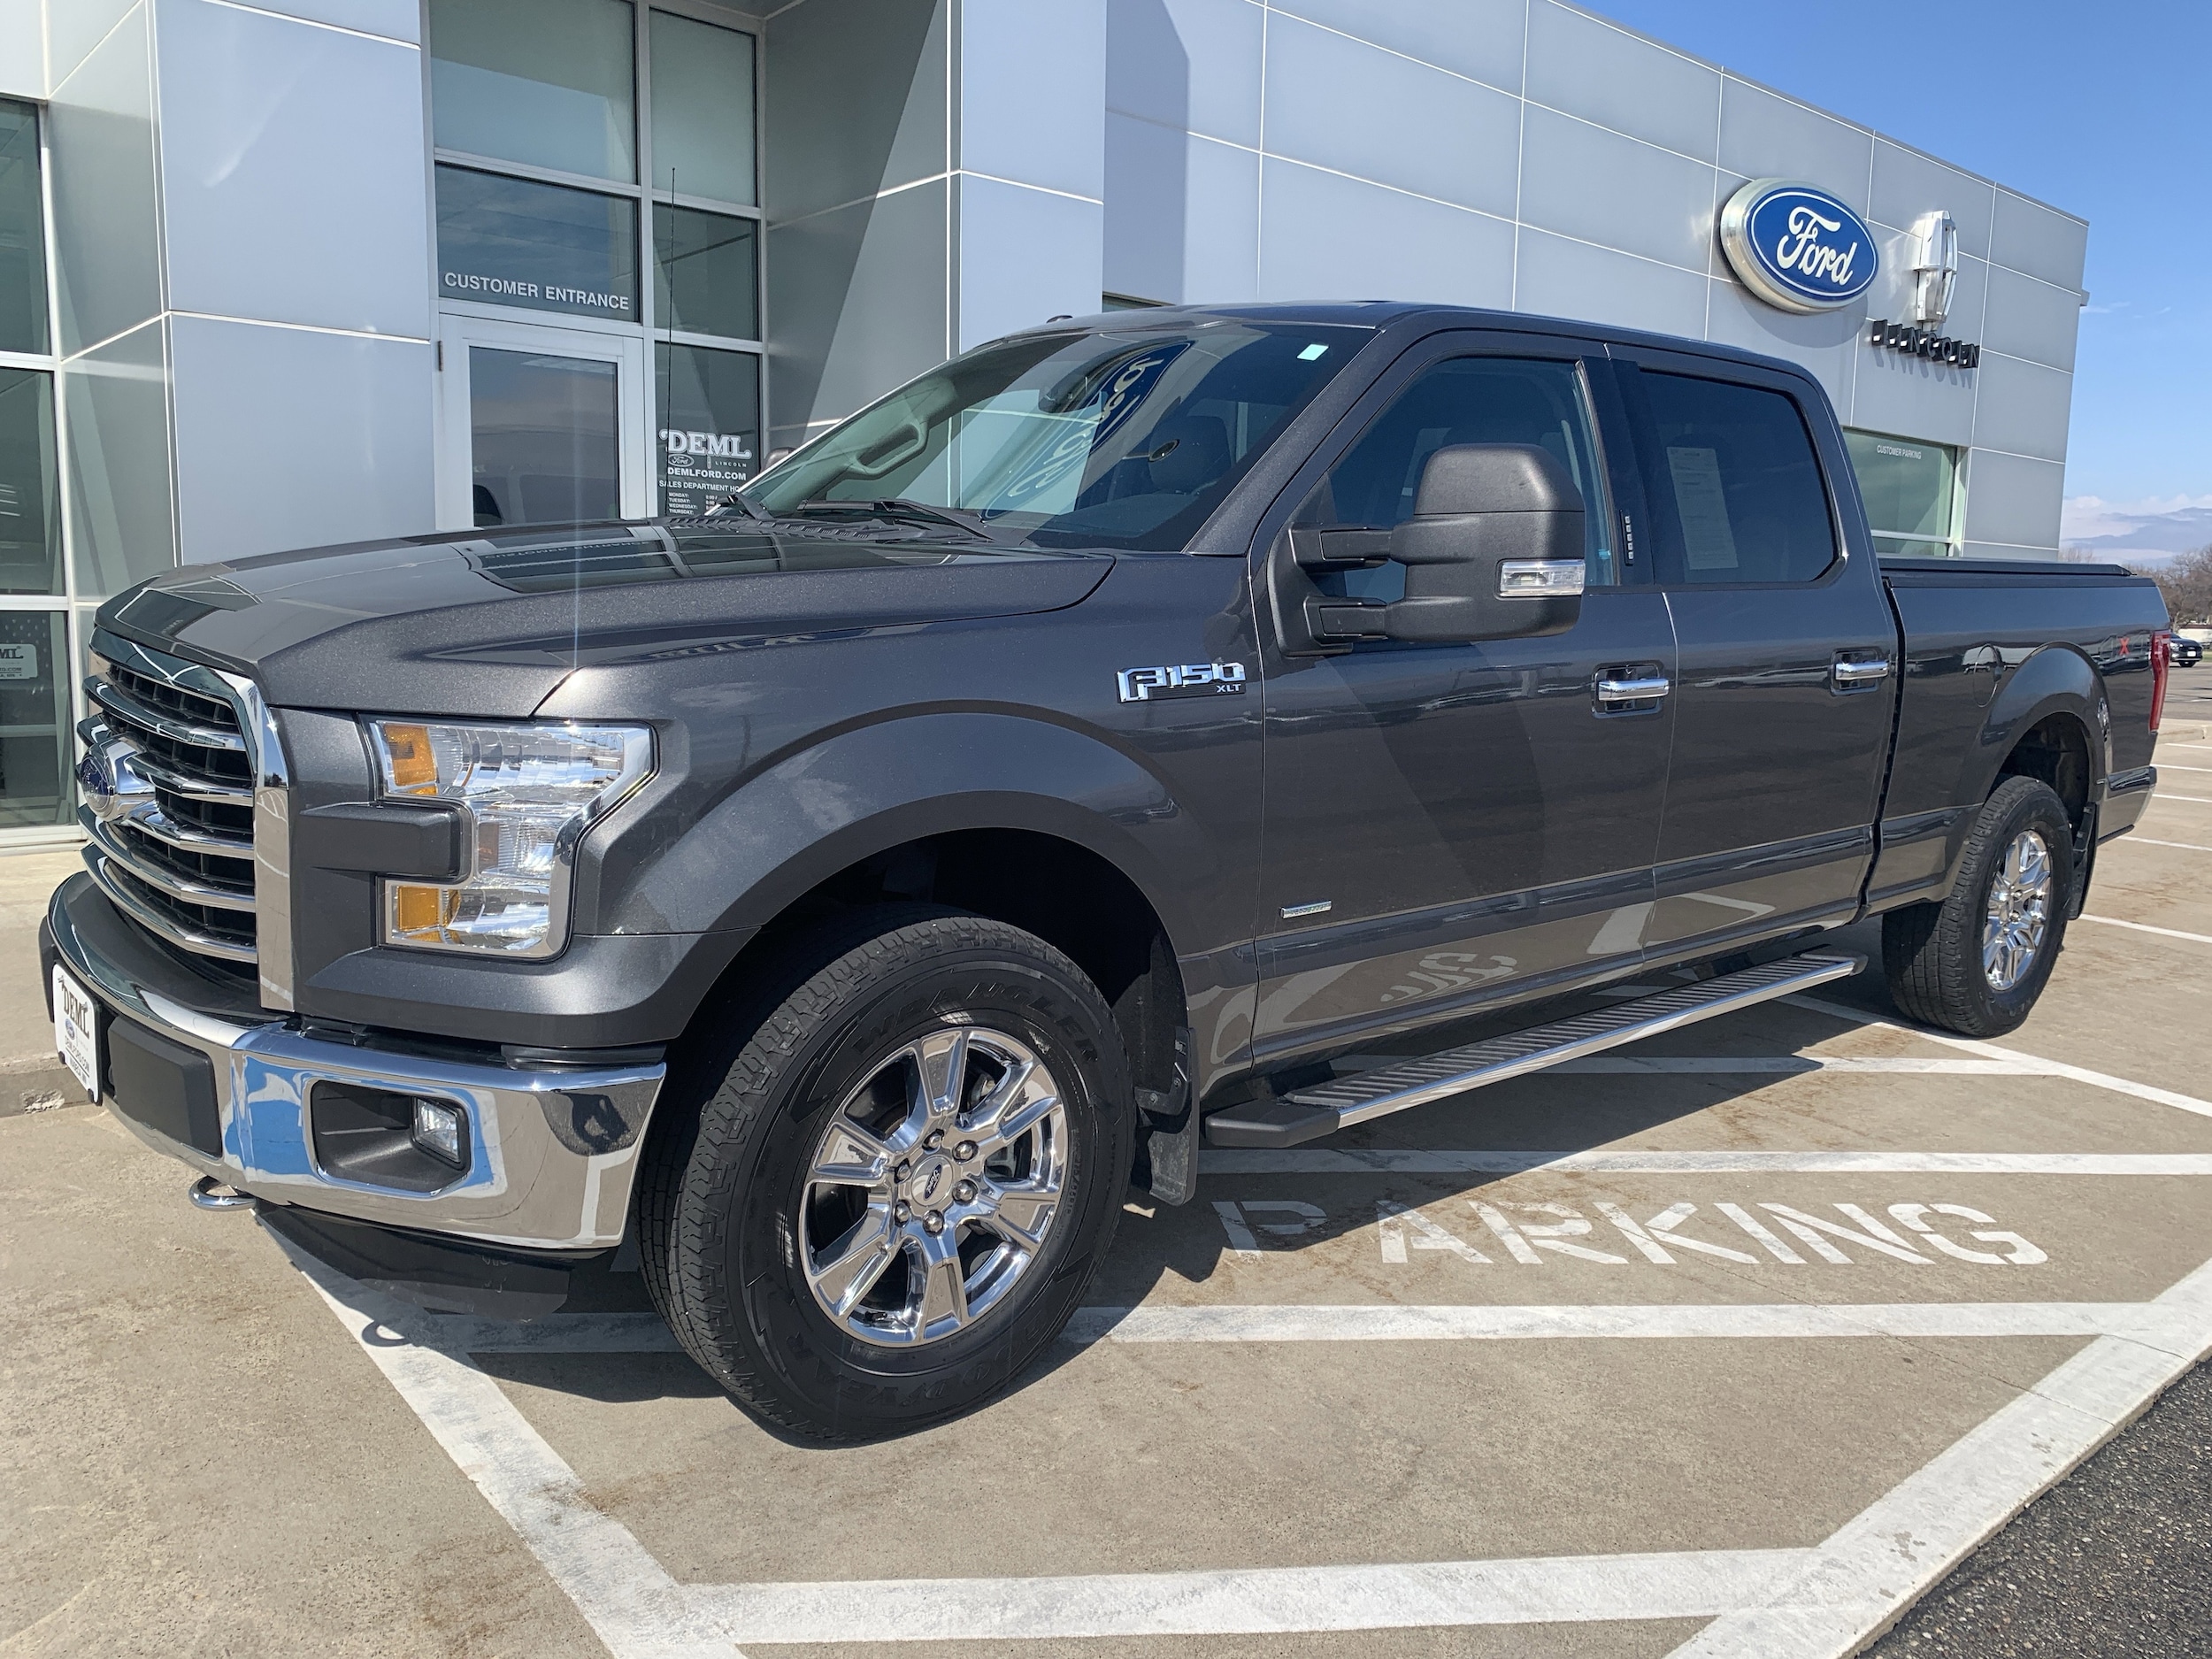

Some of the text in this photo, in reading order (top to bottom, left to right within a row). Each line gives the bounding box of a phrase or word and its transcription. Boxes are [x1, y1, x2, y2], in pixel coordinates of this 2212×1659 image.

[1777, 206, 1858, 286] Ford
[444, 272, 629, 310] CUSTOMER ENTRANCE
[1871, 319, 1980, 369] LINCOLN
[658, 428, 752, 460] DEML
[1877, 444, 1922, 460] CUSTOMER PARKING
[667, 467, 747, 480] DEMLFORD.COM
[672, 456, 688, 465] Ford
[683, 481, 729, 492] DEPARTMENT
[1216, 683, 1242, 693] XLT
[60, 982, 90, 1040] DEML
[926, 1169, 941, 1194] Ford
[1210, 1200, 2049, 1265] PARKING
